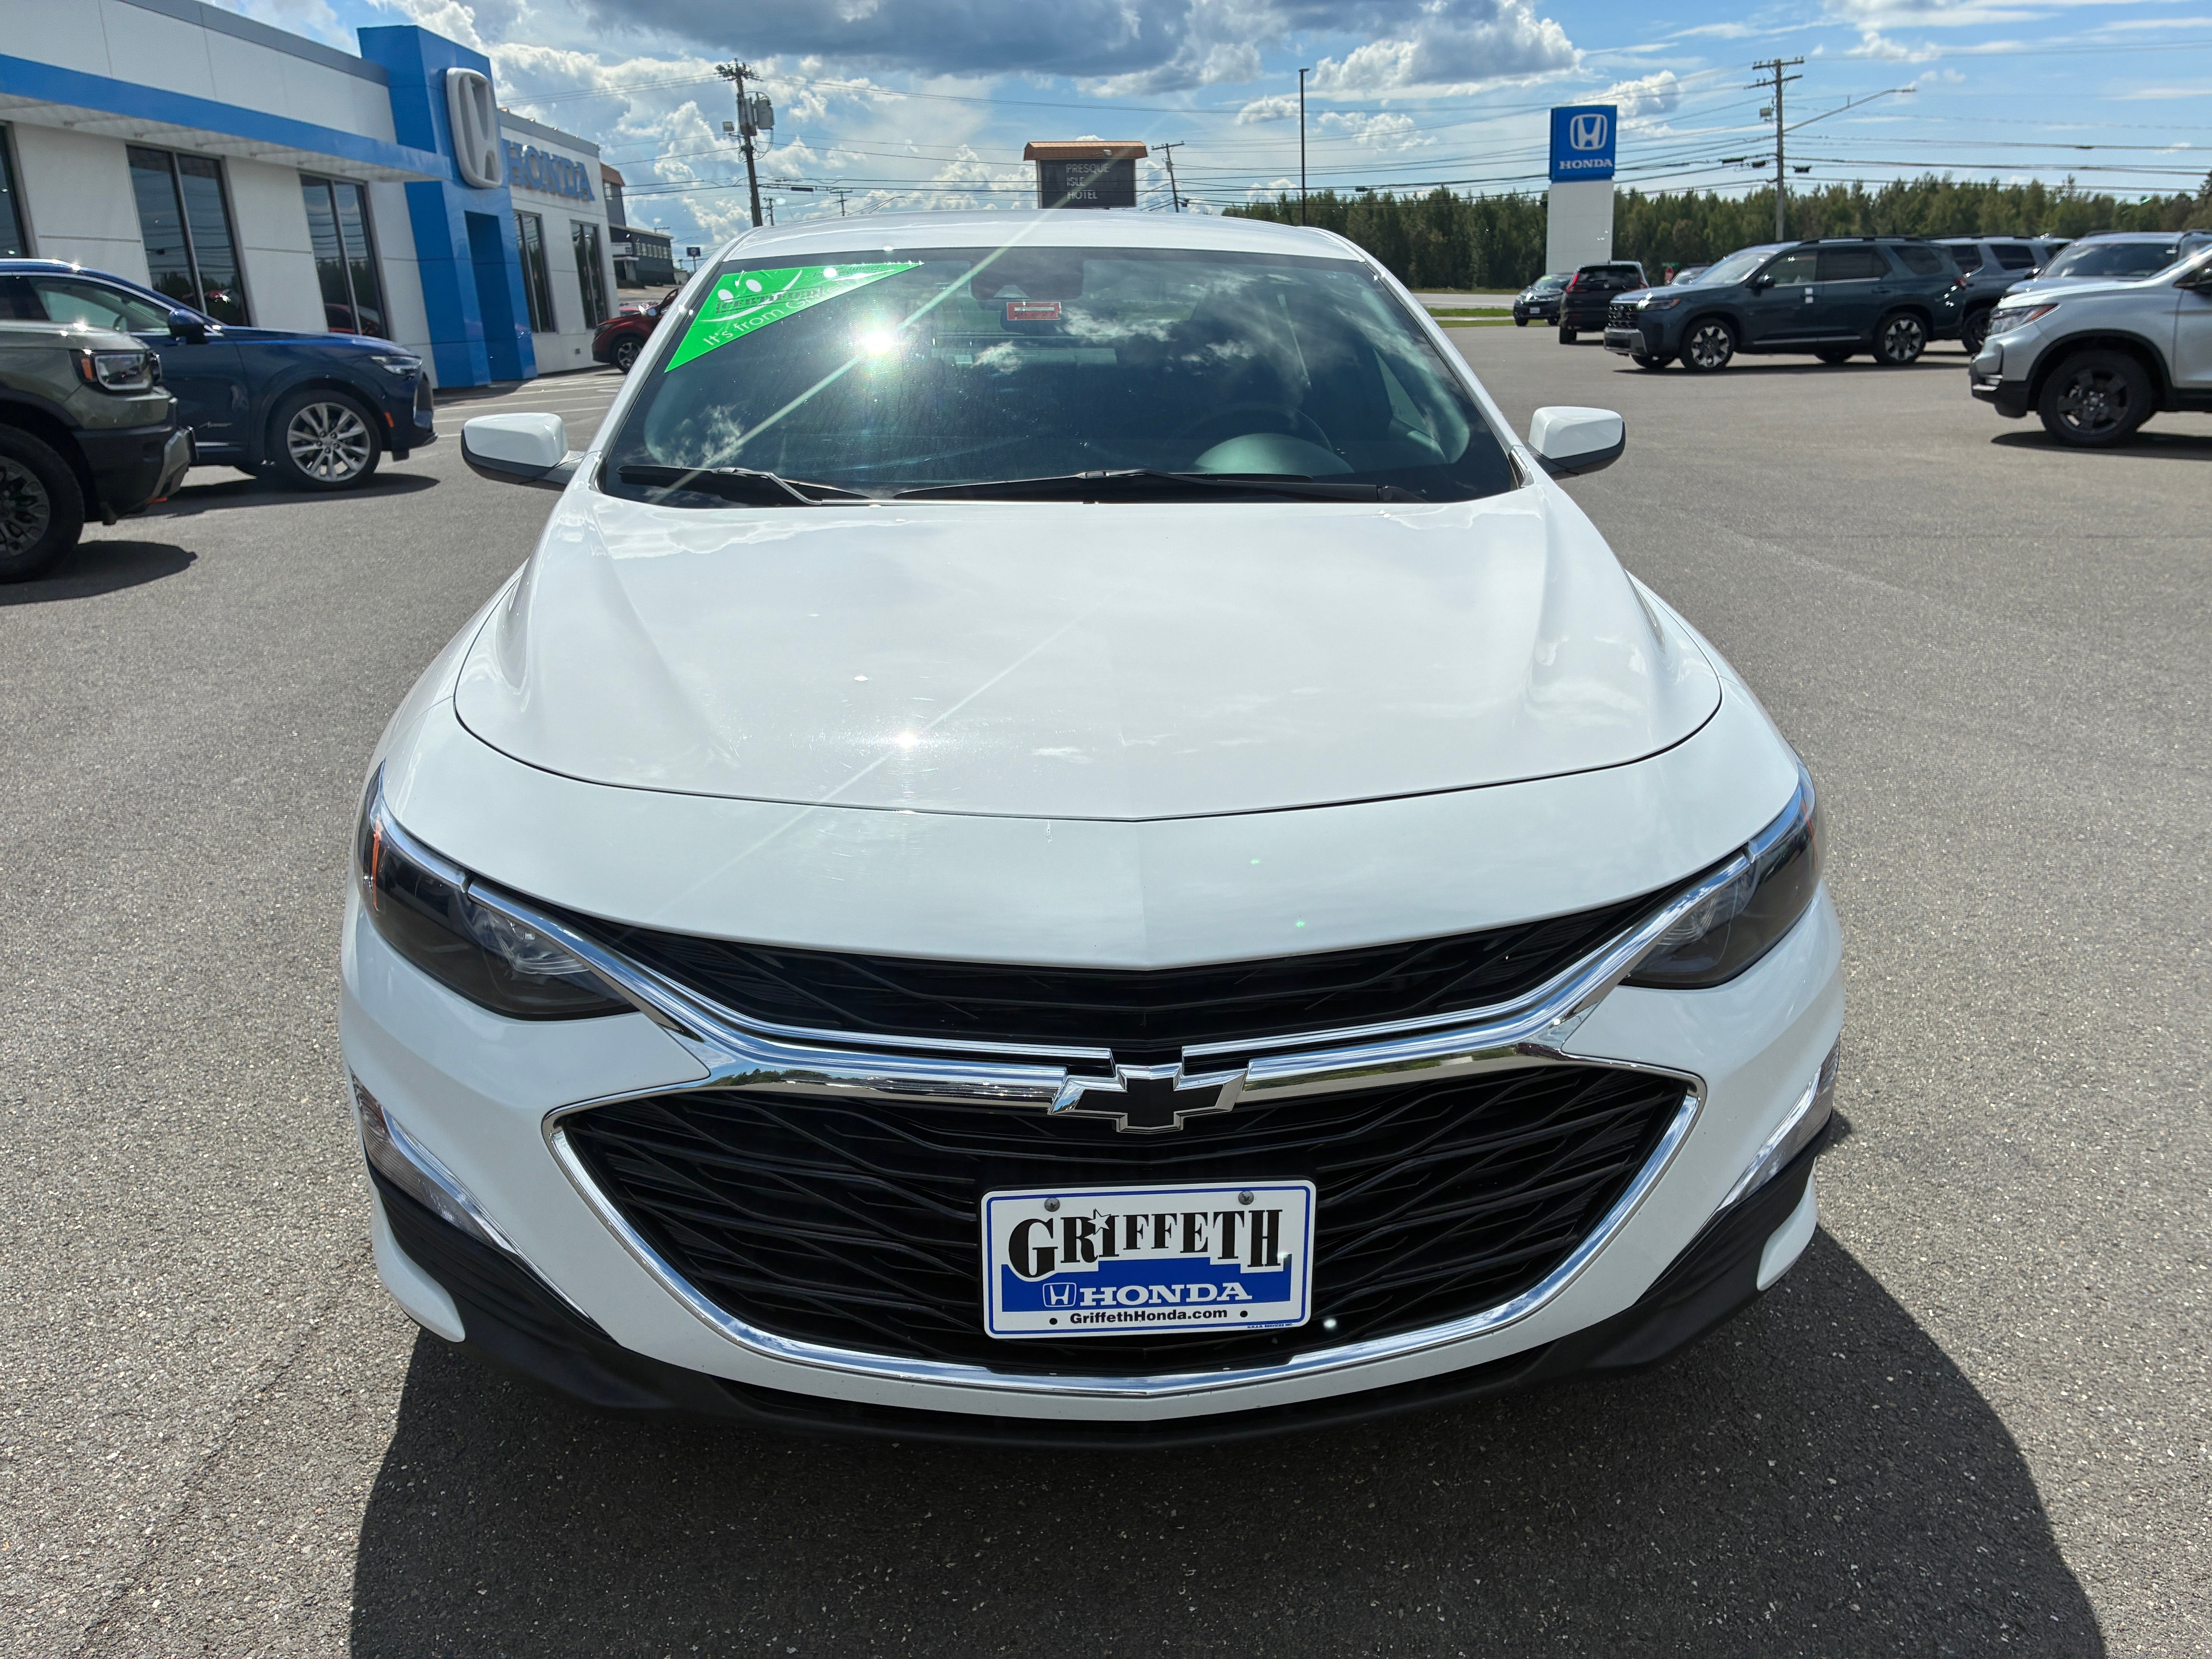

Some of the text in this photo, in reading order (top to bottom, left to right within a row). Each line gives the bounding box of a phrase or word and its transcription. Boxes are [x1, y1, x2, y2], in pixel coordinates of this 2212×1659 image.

[501, 138, 595, 201] HONDA
[1066, 163, 1110, 173] PRESQUE
[1559, 158, 1613, 170] HONDA
[1066, 177, 1084, 186] ISLE
[1067, 190, 1098, 199] HOTEL
[703, 330, 733, 346] It's
[733, 309, 785, 332] from
[1008, 1209, 1283, 1278] GRIFFETH
[1080, 1282, 1252, 1307] HONDA
[1070, 1307, 1228, 1324] GriffethHonda.com
